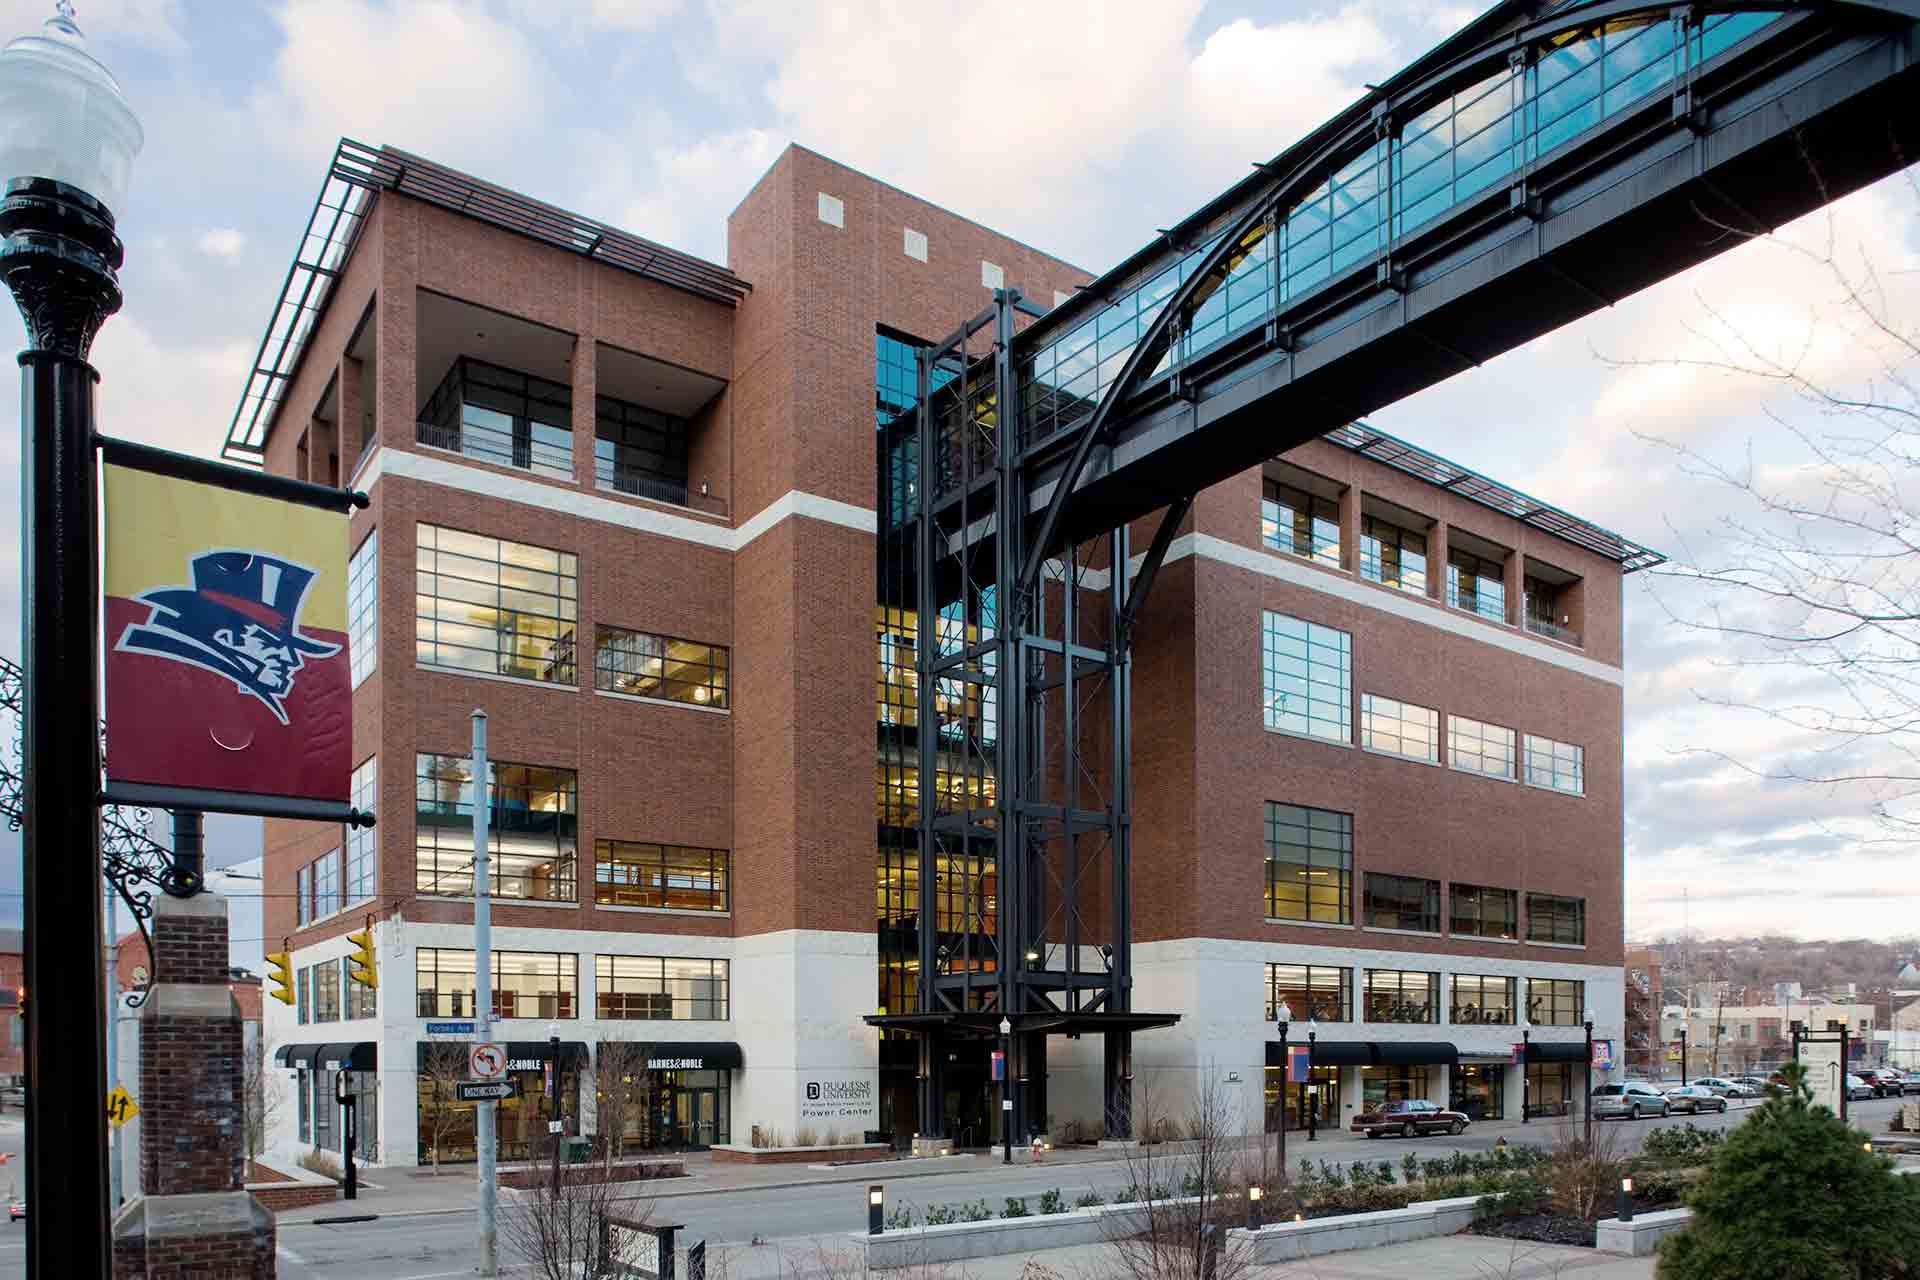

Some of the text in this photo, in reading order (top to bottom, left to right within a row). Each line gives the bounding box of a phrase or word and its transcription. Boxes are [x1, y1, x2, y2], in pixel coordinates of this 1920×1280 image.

[505, 1059, 541, 1070] S&NOBLE
[823, 1081, 871, 1090] DUQUESNE
[465, 1087, 499, 1097] ONE WAY
[823, 1089, 871, 1099] UNIVERSITY
[803, 1107, 873, 1117] Power Center
